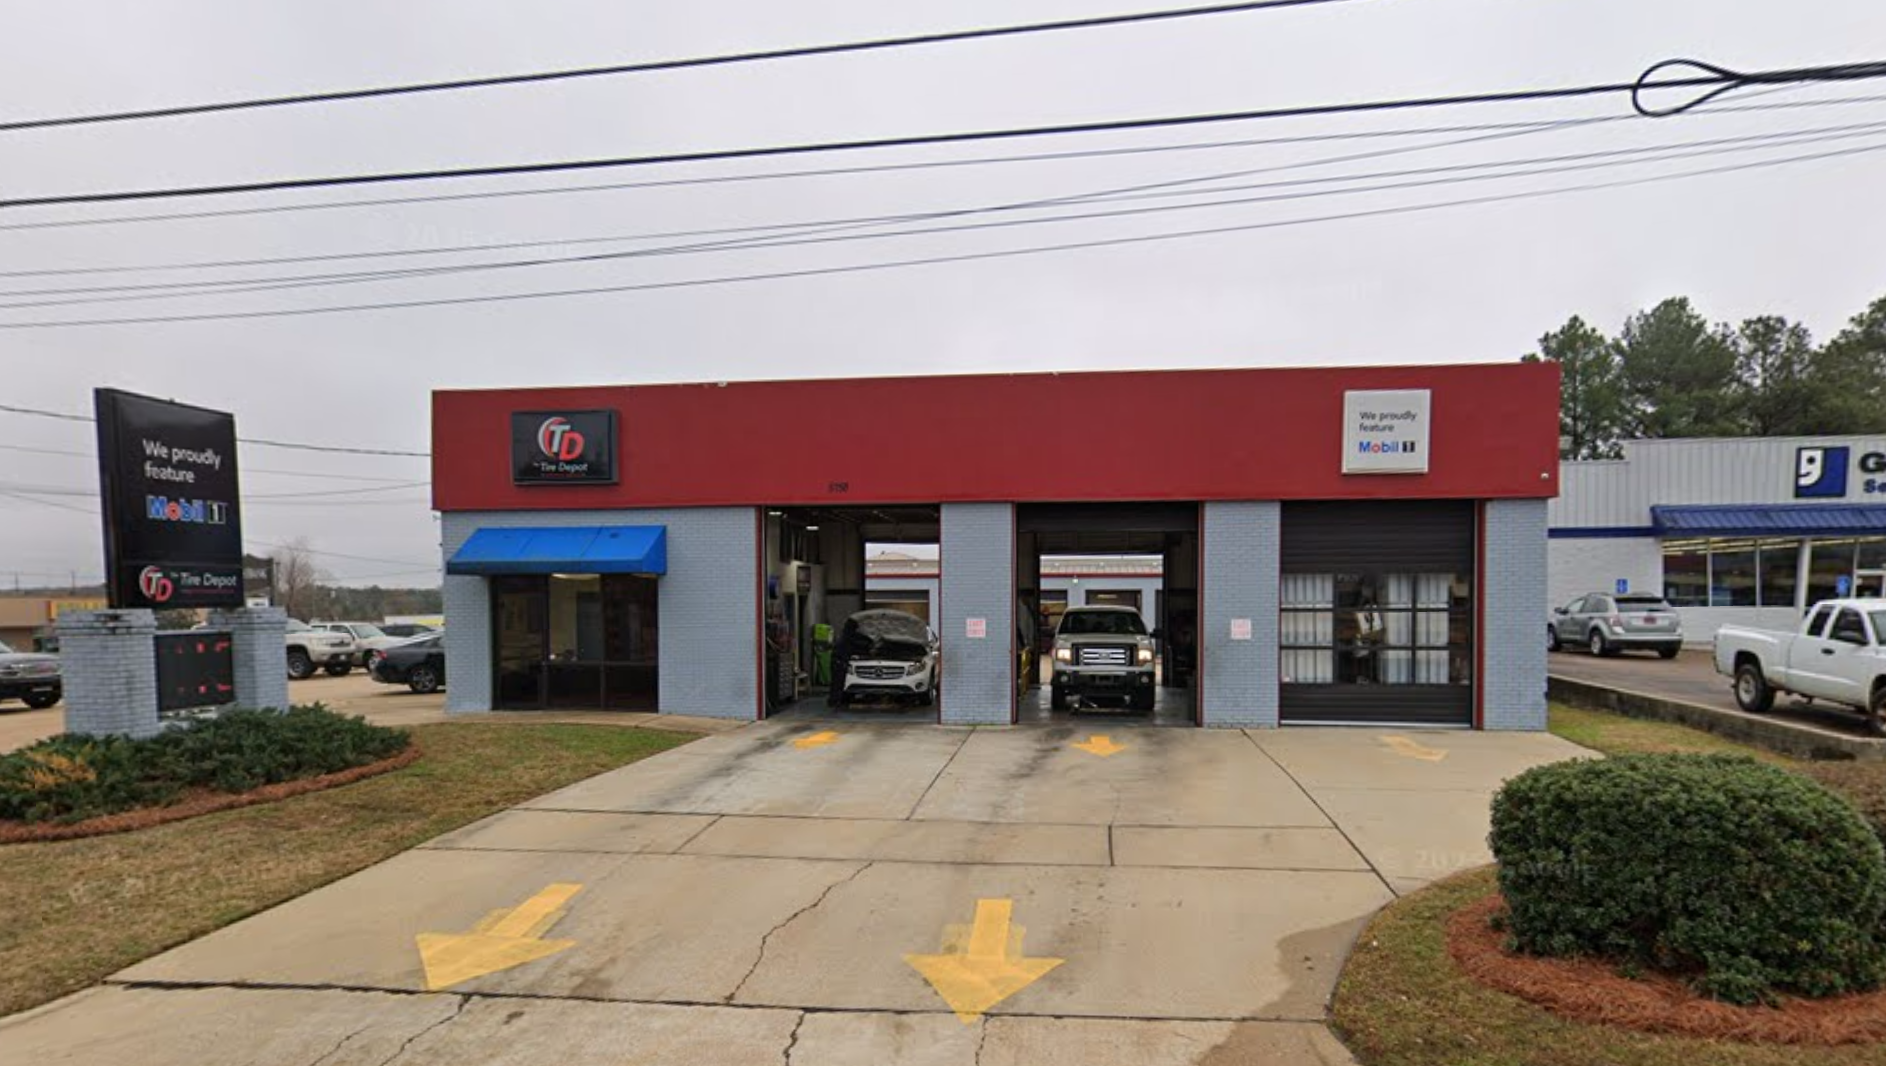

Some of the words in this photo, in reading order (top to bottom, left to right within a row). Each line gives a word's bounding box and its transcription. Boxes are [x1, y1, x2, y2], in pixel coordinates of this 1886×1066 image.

[1359, 411, 1377, 420] We
[1380, 410, 1417, 422] proudly
[1359, 422, 1395, 432] feature
[546, 421, 585, 461] TD
[1359, 441, 1399, 453] Mobil
[142, 438, 168, 459] We
[171, 444, 222, 471] proudly
[143, 460, 195, 483] feature
[541, 462, 556, 472] Tire
[559, 462, 588, 473] Depot
[146, 495, 204, 523] Mobil
[146, 569, 173, 602] TD
[180, 572, 201, 586] Tire
[203, 572, 236, 589] Depot
